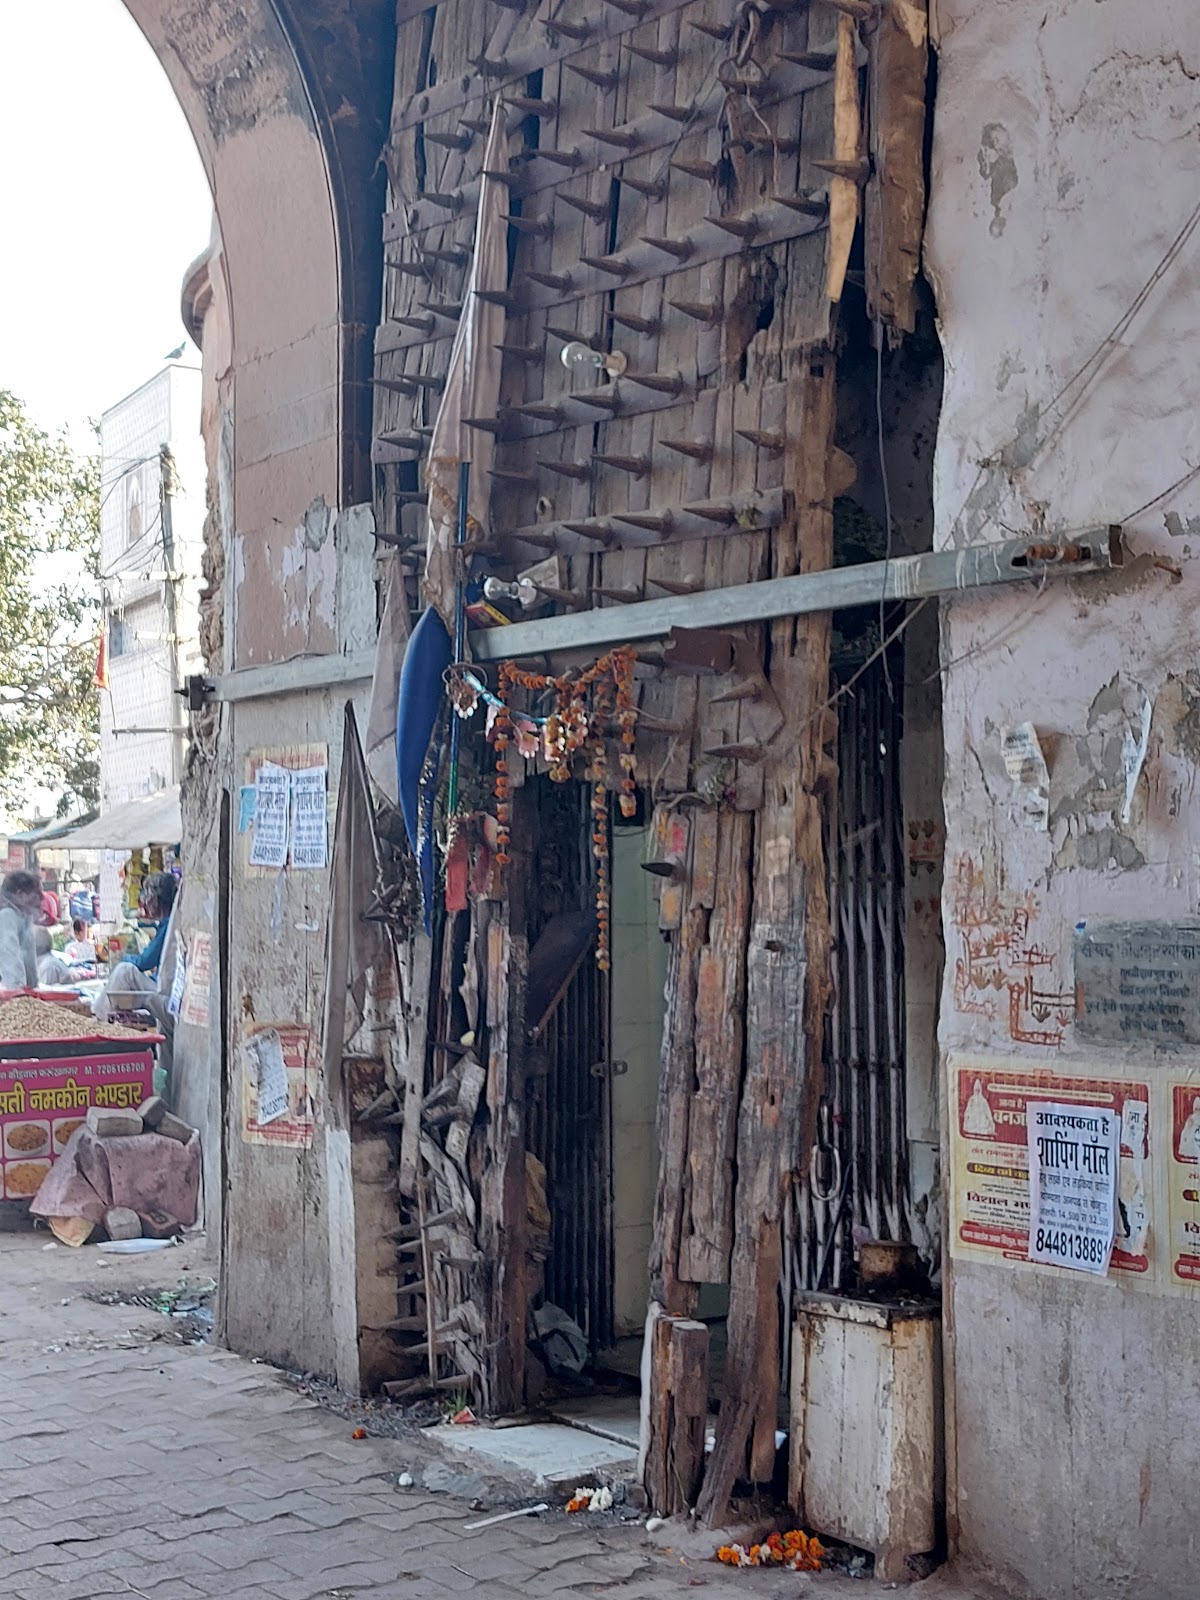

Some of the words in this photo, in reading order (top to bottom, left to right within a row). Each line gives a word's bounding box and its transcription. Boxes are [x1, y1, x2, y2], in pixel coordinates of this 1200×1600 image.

[29, 1077, 91, 1111] नमकीन
[95, 1082, 143, 1108] भण्डार
[1036, 1112, 1099, 1132] आवश्यकता
[1100, 1116, 1110, 1136] है
[1082, 1135, 1110, 1175] मॉल
